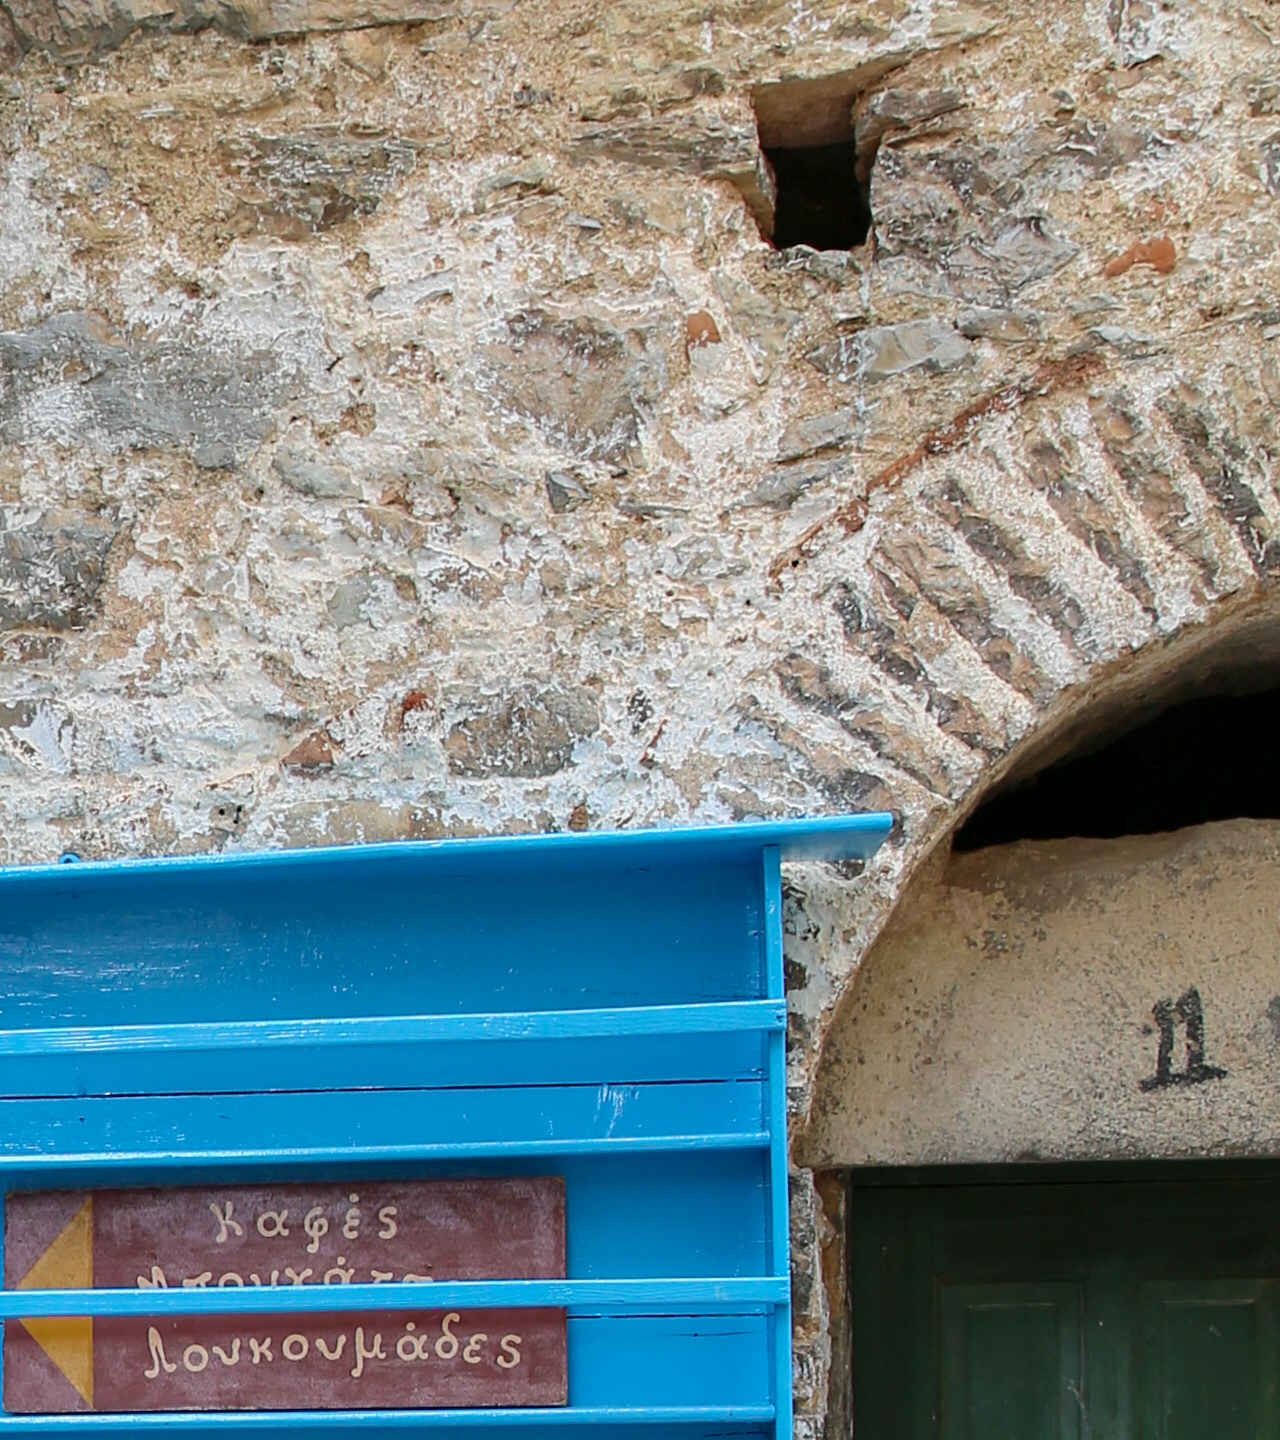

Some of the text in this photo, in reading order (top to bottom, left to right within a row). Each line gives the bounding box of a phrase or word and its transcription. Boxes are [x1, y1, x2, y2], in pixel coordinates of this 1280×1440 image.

[1139, 984, 1228, 1093] 11
[210, 1193, 398, 1254] Καφές
[144, 1312, 521, 1378] Λουκουμάδες
